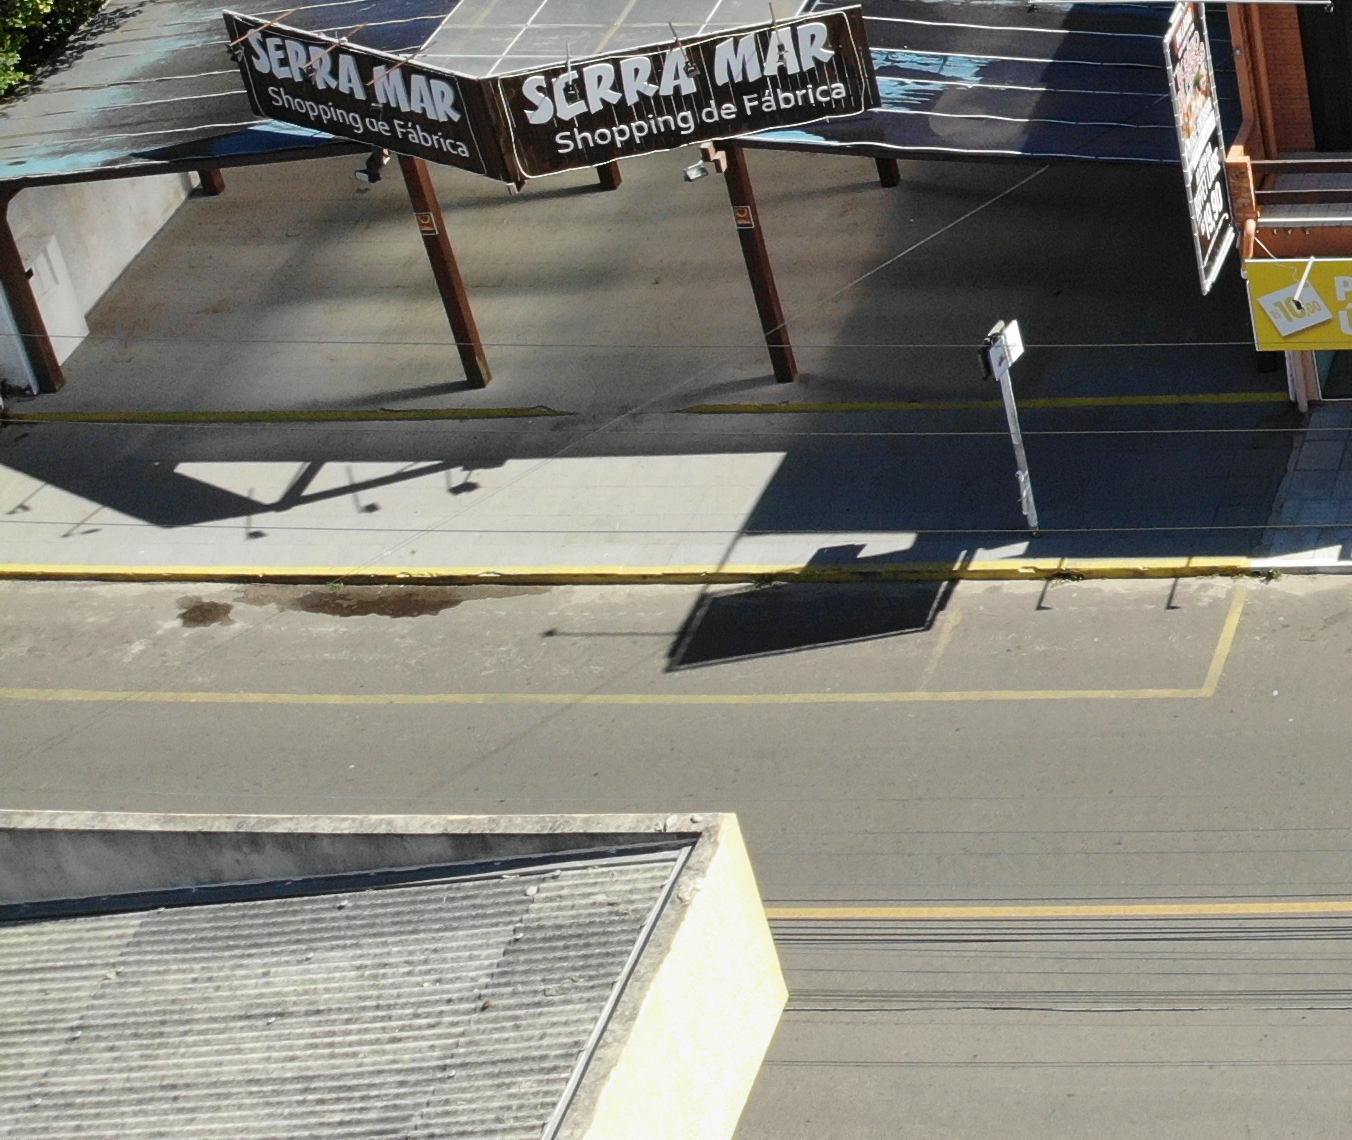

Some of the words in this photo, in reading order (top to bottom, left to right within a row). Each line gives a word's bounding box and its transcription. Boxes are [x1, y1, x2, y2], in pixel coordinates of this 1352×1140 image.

[248, 29, 367, 101] SERRA
[373, 64, 461, 124] MAR
[522, 47, 697, 125] SERRA
[714, 22, 835, 87] MAR
[267, 86, 363, 134] Shopping
[366, 113, 391, 136] de
[393, 119, 470, 158] Fábrica
[555, 110, 696, 154] Shopping
[701, 99, 738, 124] de
[743, 82, 847, 116] Fábrica
